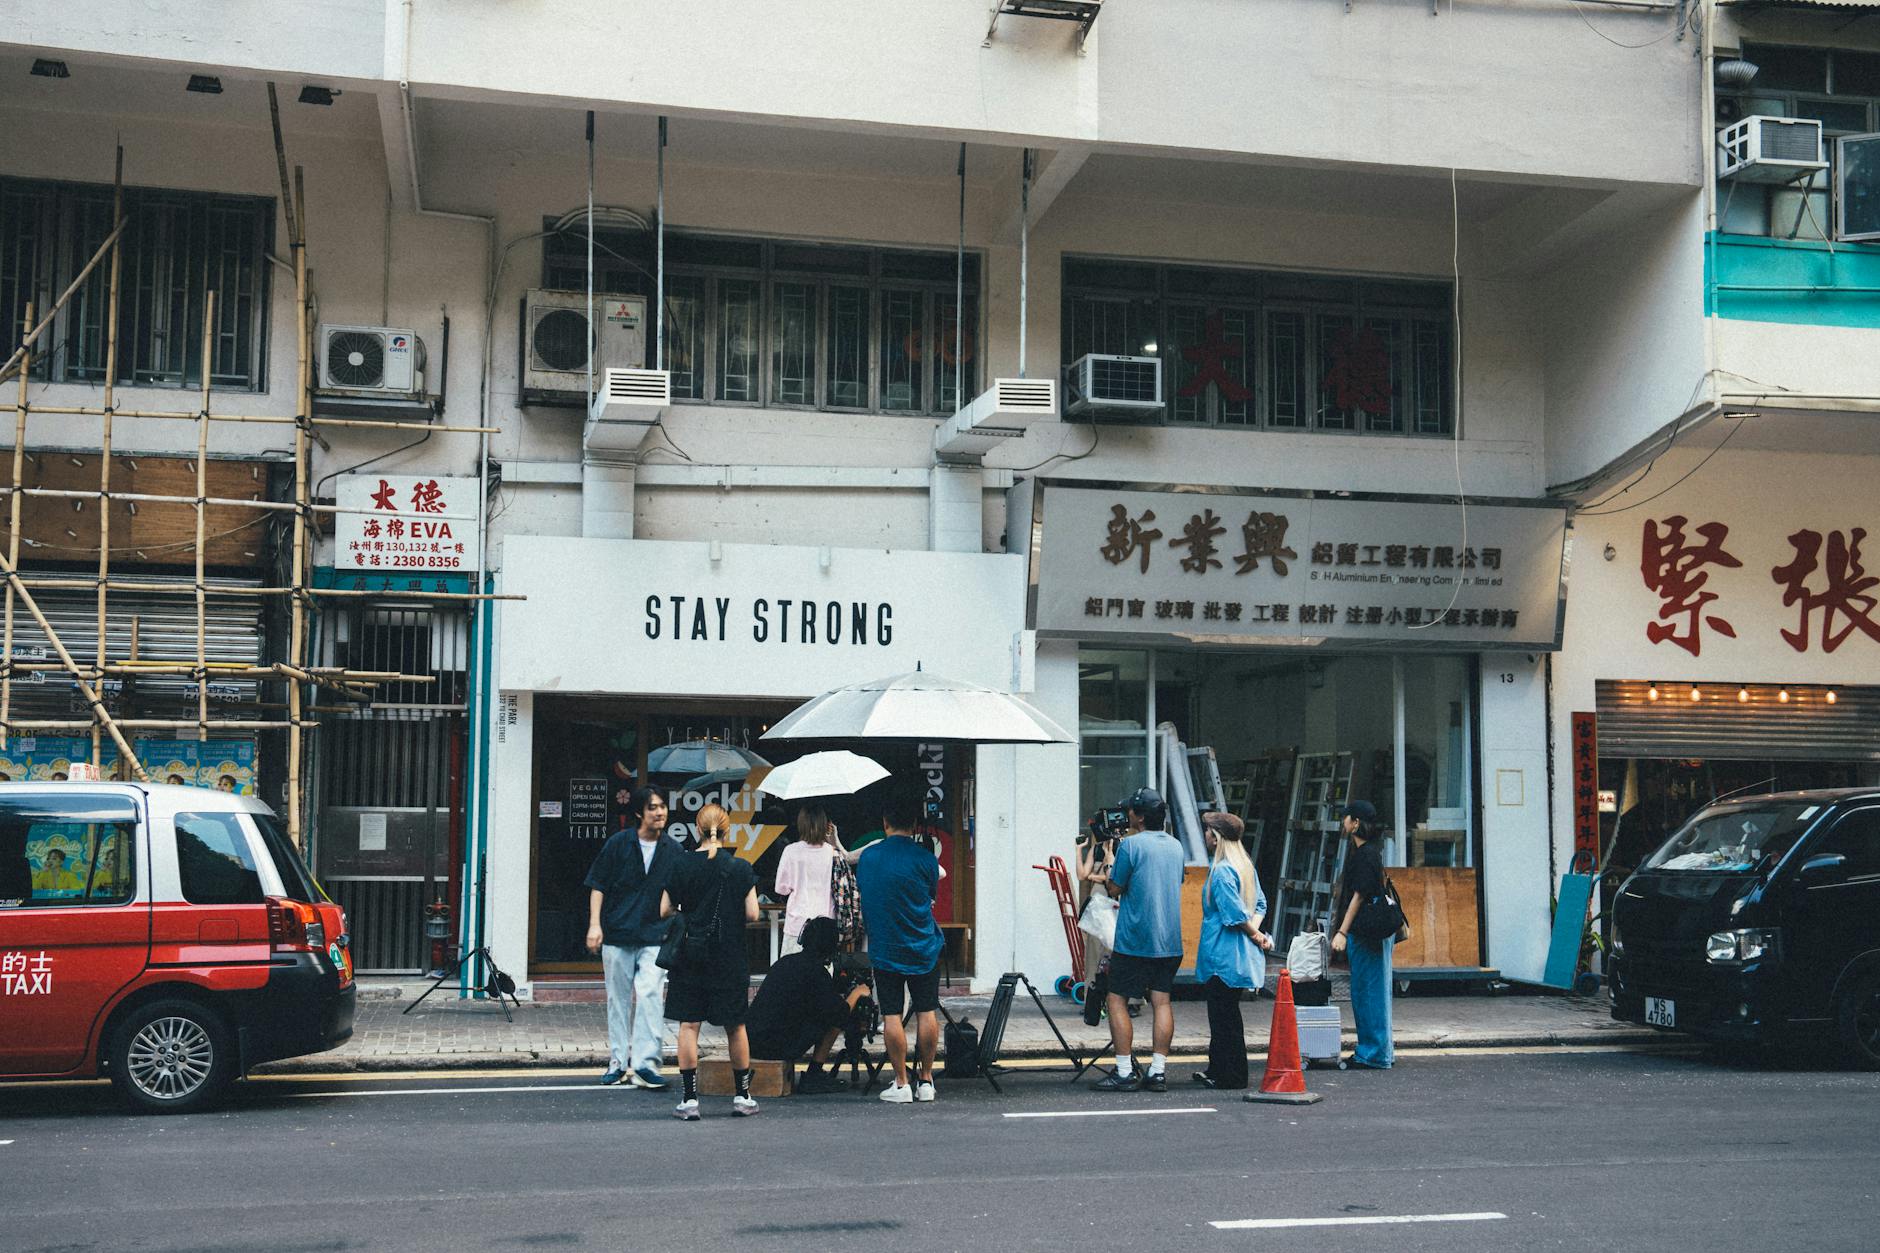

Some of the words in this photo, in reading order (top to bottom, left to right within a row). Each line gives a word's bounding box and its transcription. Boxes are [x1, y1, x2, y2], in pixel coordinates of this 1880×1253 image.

[370, 479, 447, 513] 大德
[410, 522, 453, 538] EVA
[1100, 503, 1298, 576] 新業興
[428, 556, 460, 567] 8356
[1332, 572, 1378, 583] Aluminium
[1641, 515, 1880, 657] 緊張
[645, 594, 730, 641] STAY
[753, 598, 892, 646] STRONG
[1500, 673, 1514, 684] 13
[508, 695, 517, 706] THE
[508, 708, 517, 725] PARK
[667, 727, 750, 750] YEARS
[569, 825, 607, 839] YEARS
[667, 822, 764, 851] evry
[2, 951, 53, 972] 的士
[1, 973, 52, 995] TAXI
[1653, 1000, 1666, 1011] WS
[1648, 1010, 1673, 1026] 4780
